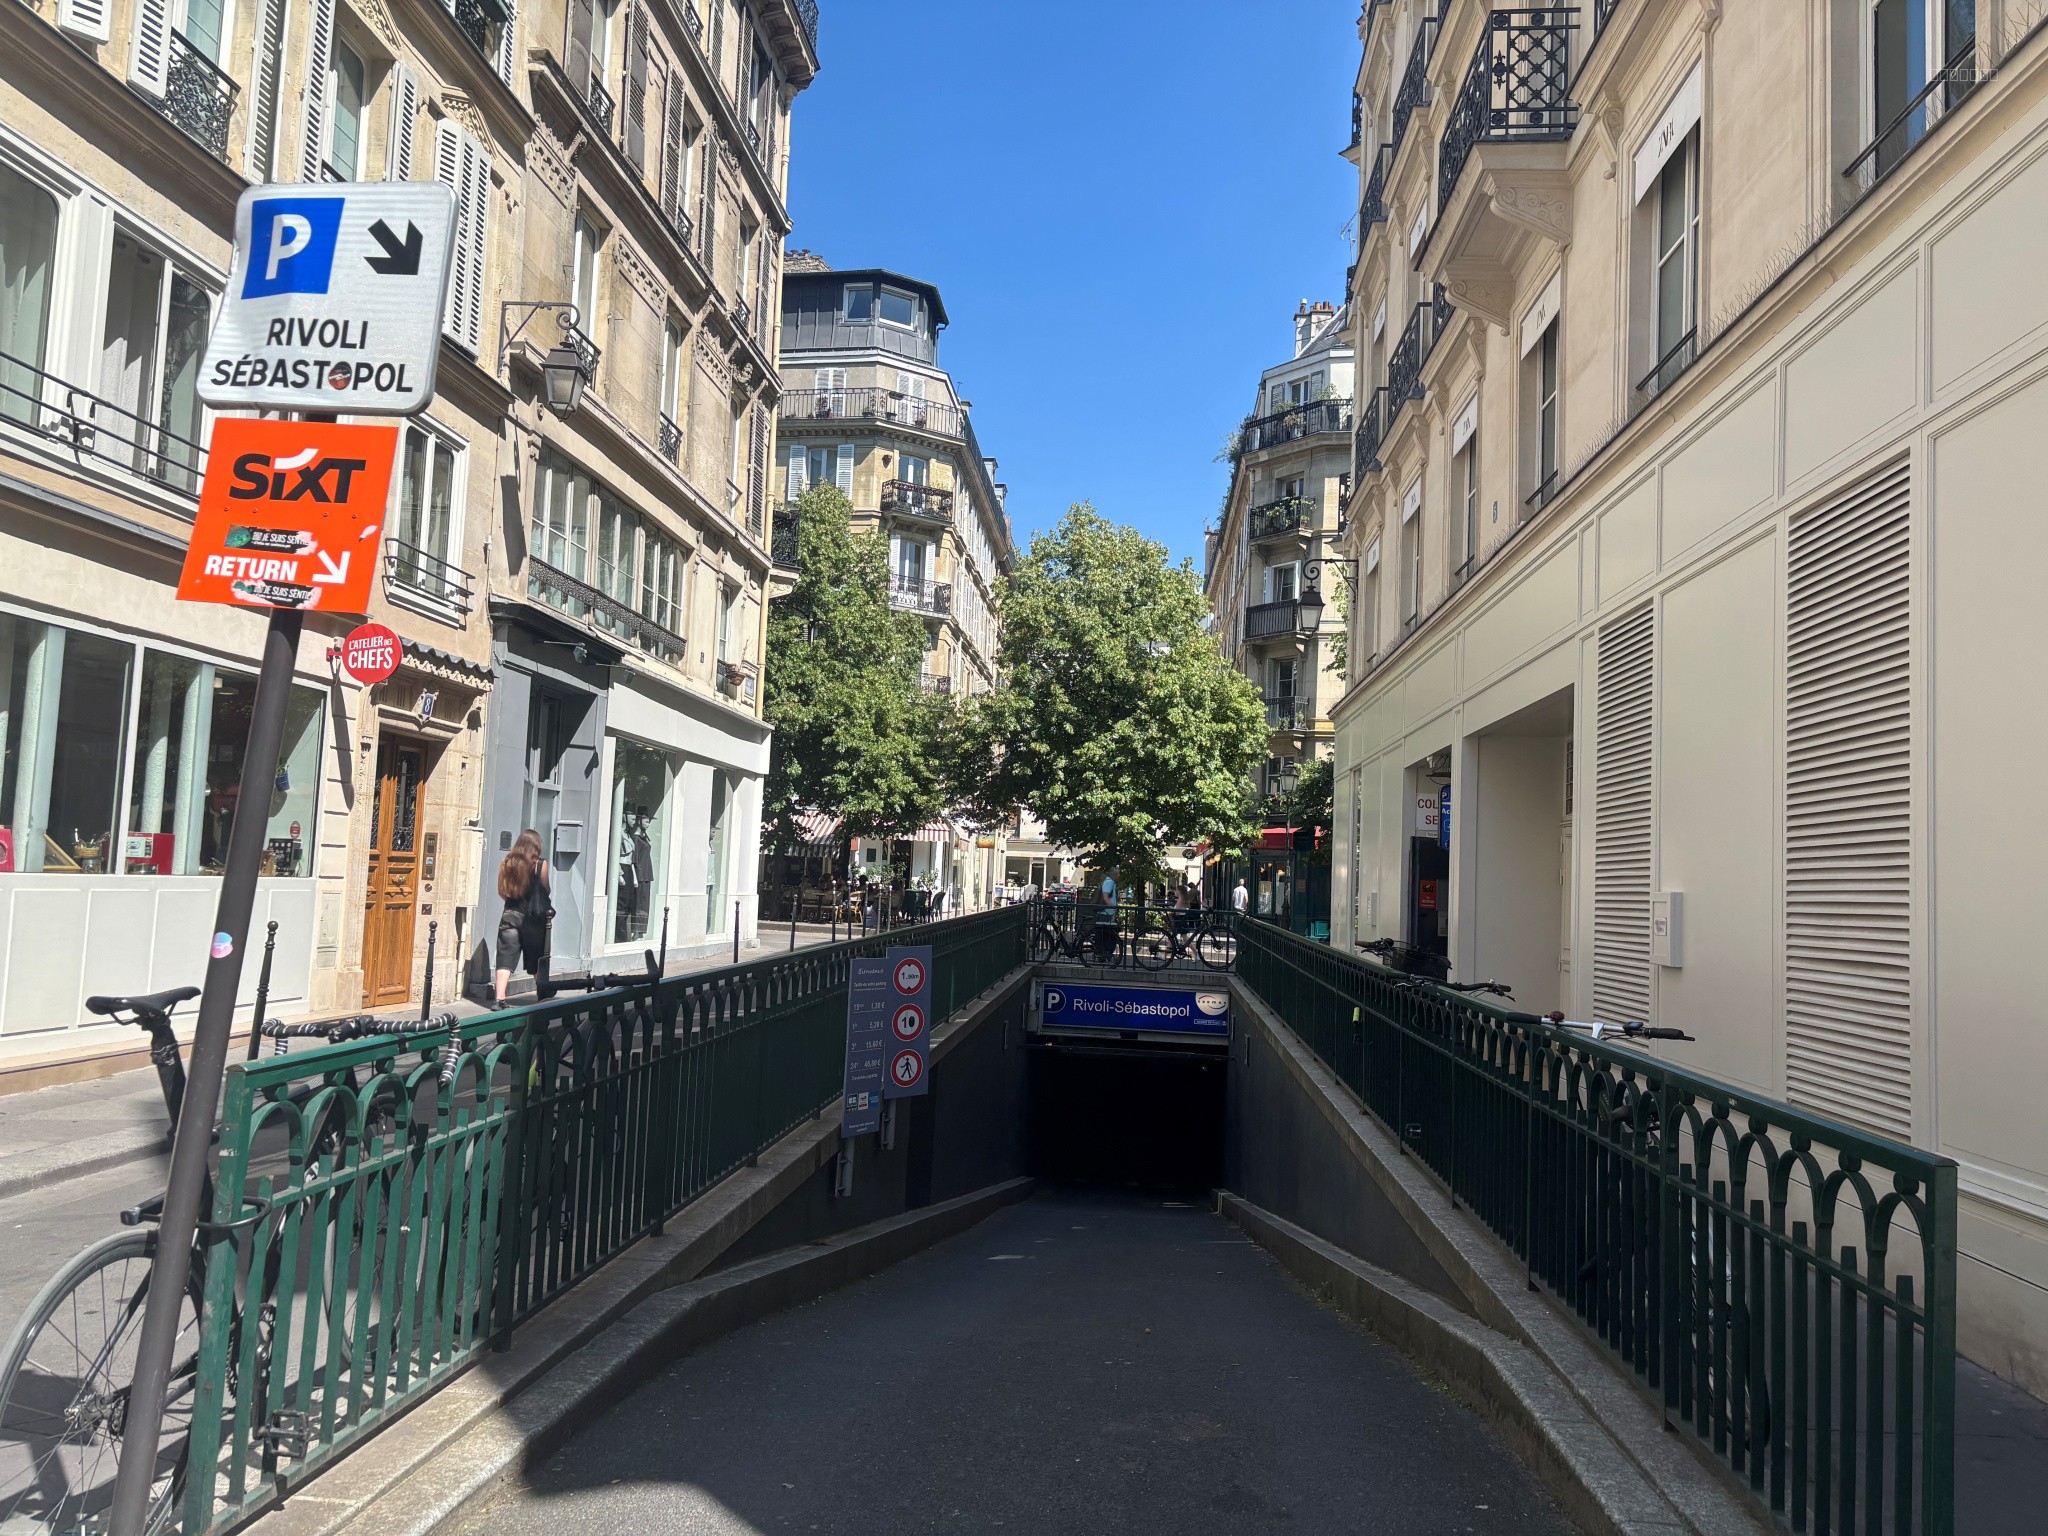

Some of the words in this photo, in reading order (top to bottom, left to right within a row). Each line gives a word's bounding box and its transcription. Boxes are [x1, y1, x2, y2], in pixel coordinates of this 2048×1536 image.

[265, 213, 312, 281] P
[265, 316, 369, 350] RIVOLI
[210, 353, 413, 393] SÉBASTPOL
[270, 534, 287, 544] SUIS
[204, 553, 298, 582] RETURN
[271, 587, 288, 597] SUIS
[348, 635, 384, 650] L'ATELIER
[384, 638, 393, 646] DES
[348, 647, 393, 669] CHEFS
[425, 696, 431, 712] 8
[1047, 992, 1060, 1009] P
[1073, 998, 1190, 1019] Rivoli-Sébastopol
[902, 1015, 916, 1029] 10
